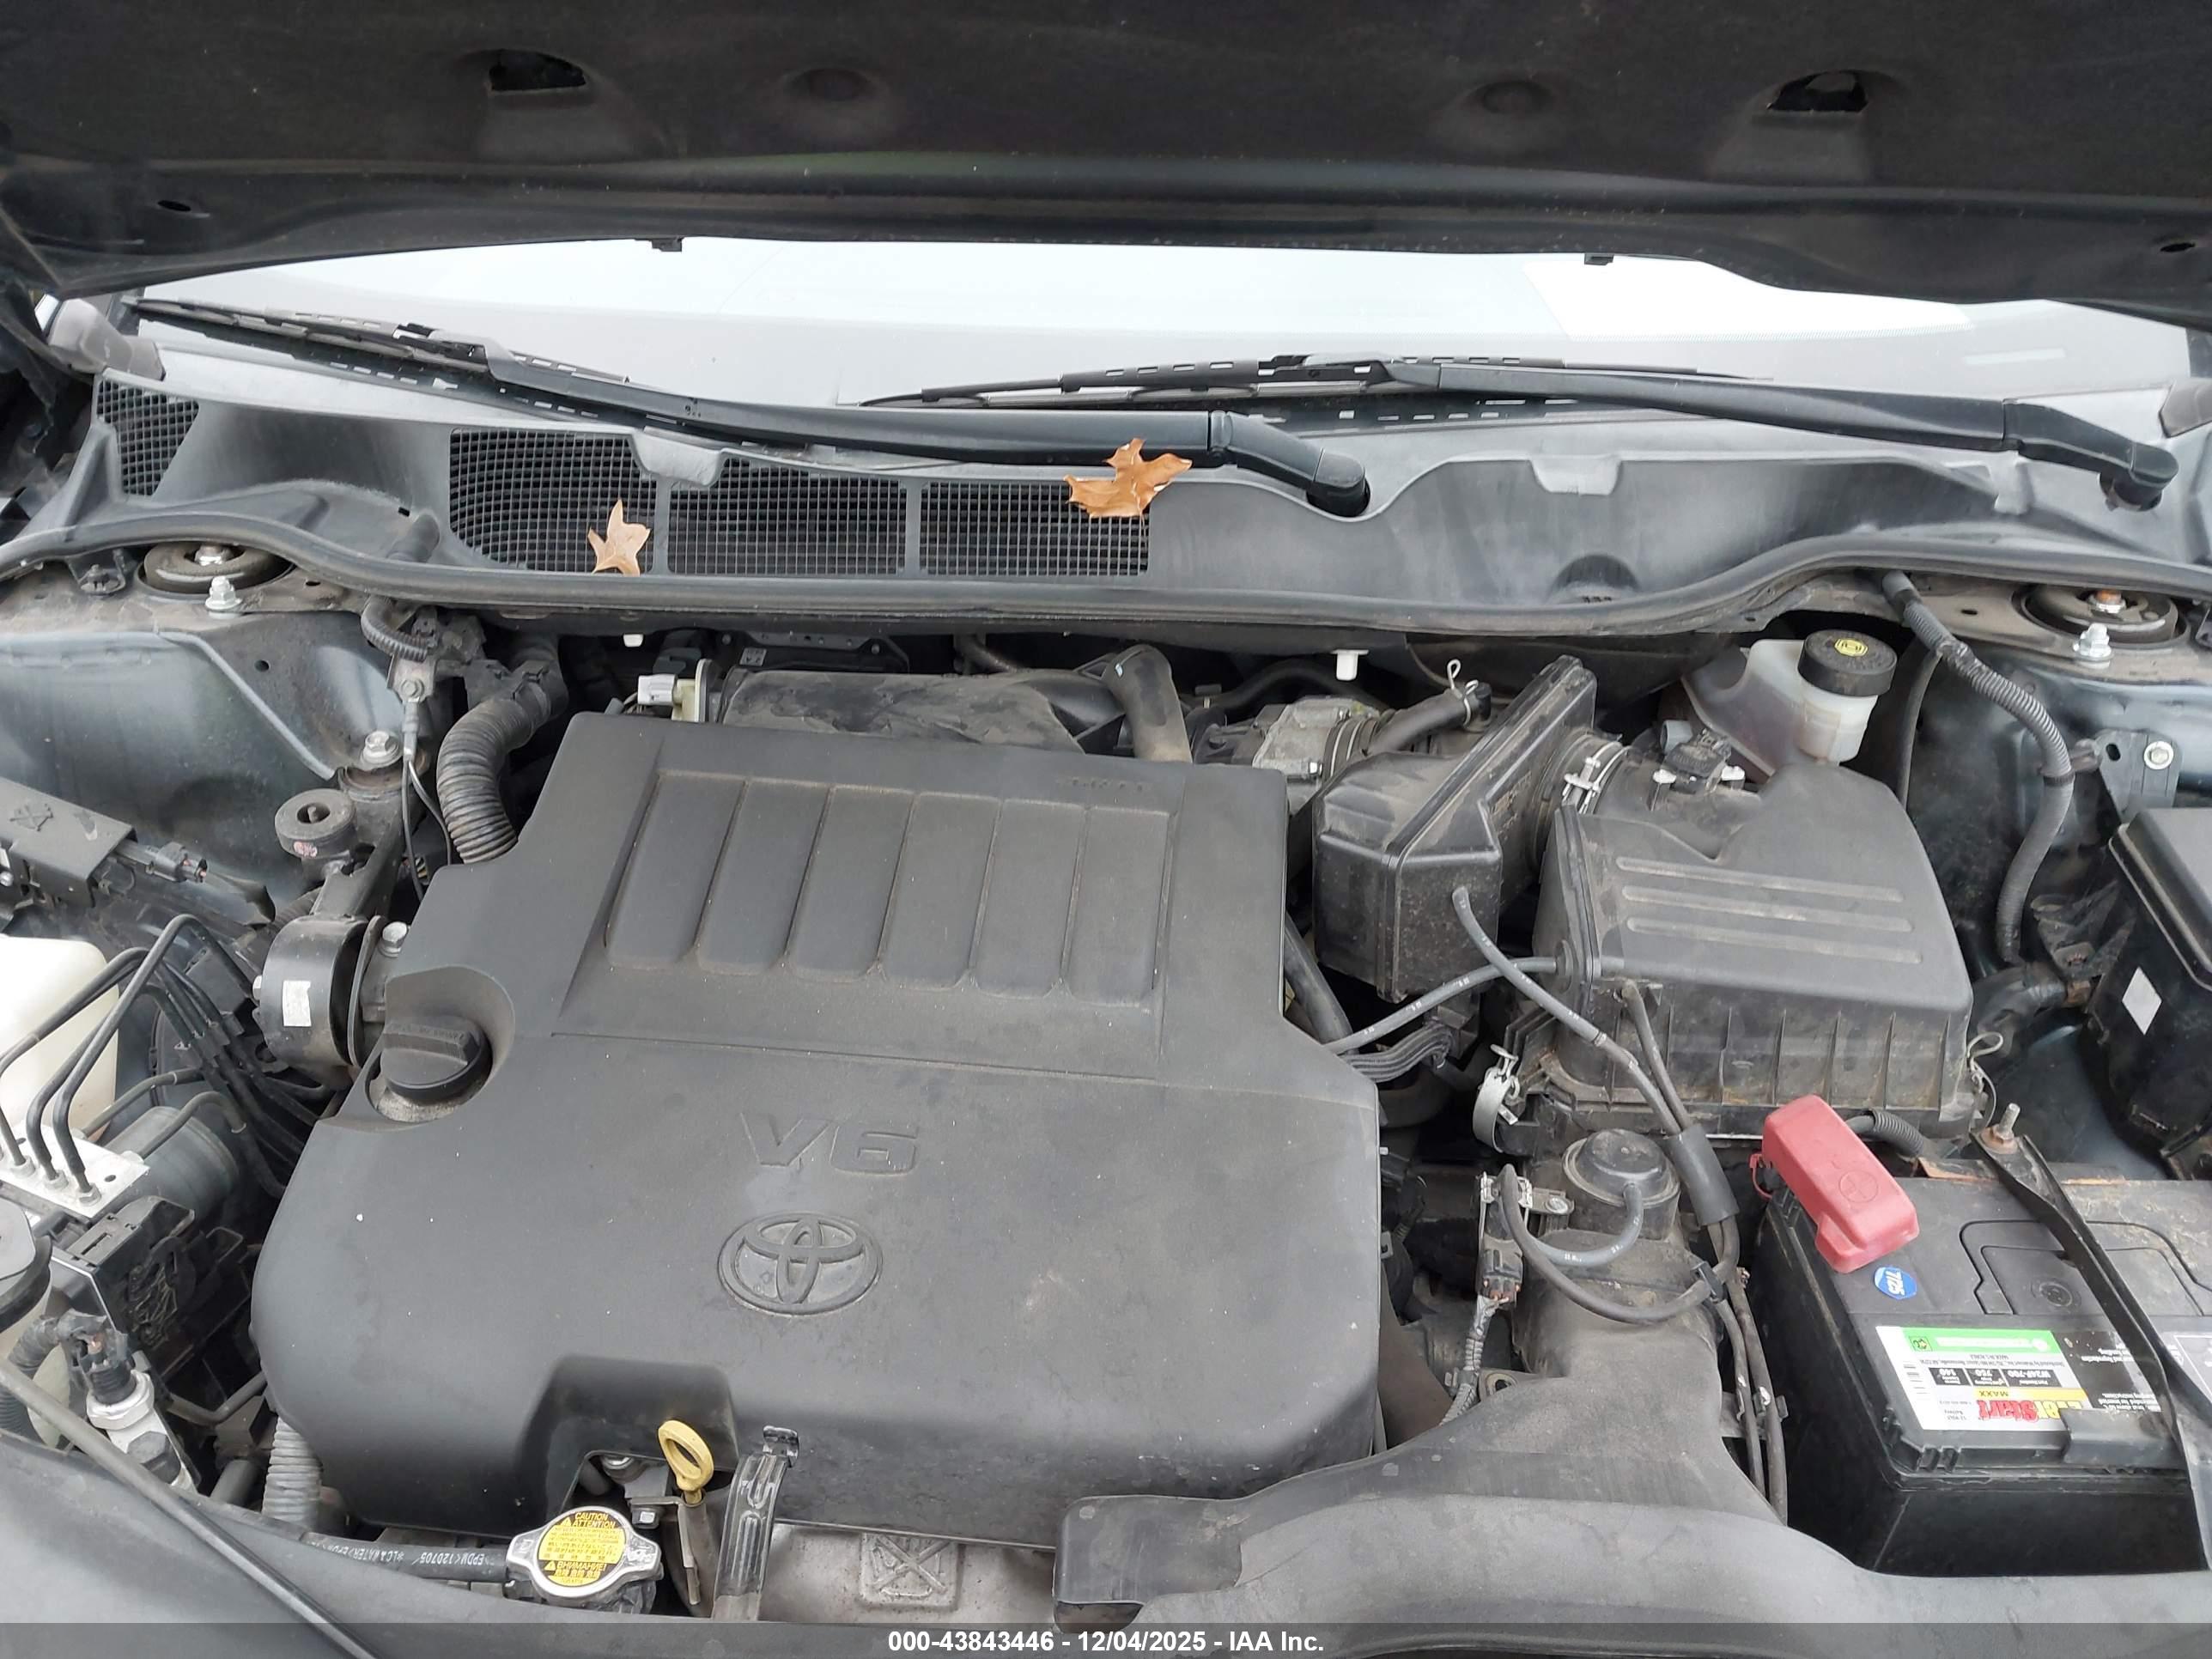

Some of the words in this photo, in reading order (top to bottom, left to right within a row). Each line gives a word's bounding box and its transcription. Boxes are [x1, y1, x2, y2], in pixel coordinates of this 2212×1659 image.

[739, 1112, 920, 1176] V6
[574, 1512, 609, 1521] CAUTION
[572, 1519, 616, 1528] ATTENTION
[556, 1561, 607, 1571] ВНИМАНИЕ!
